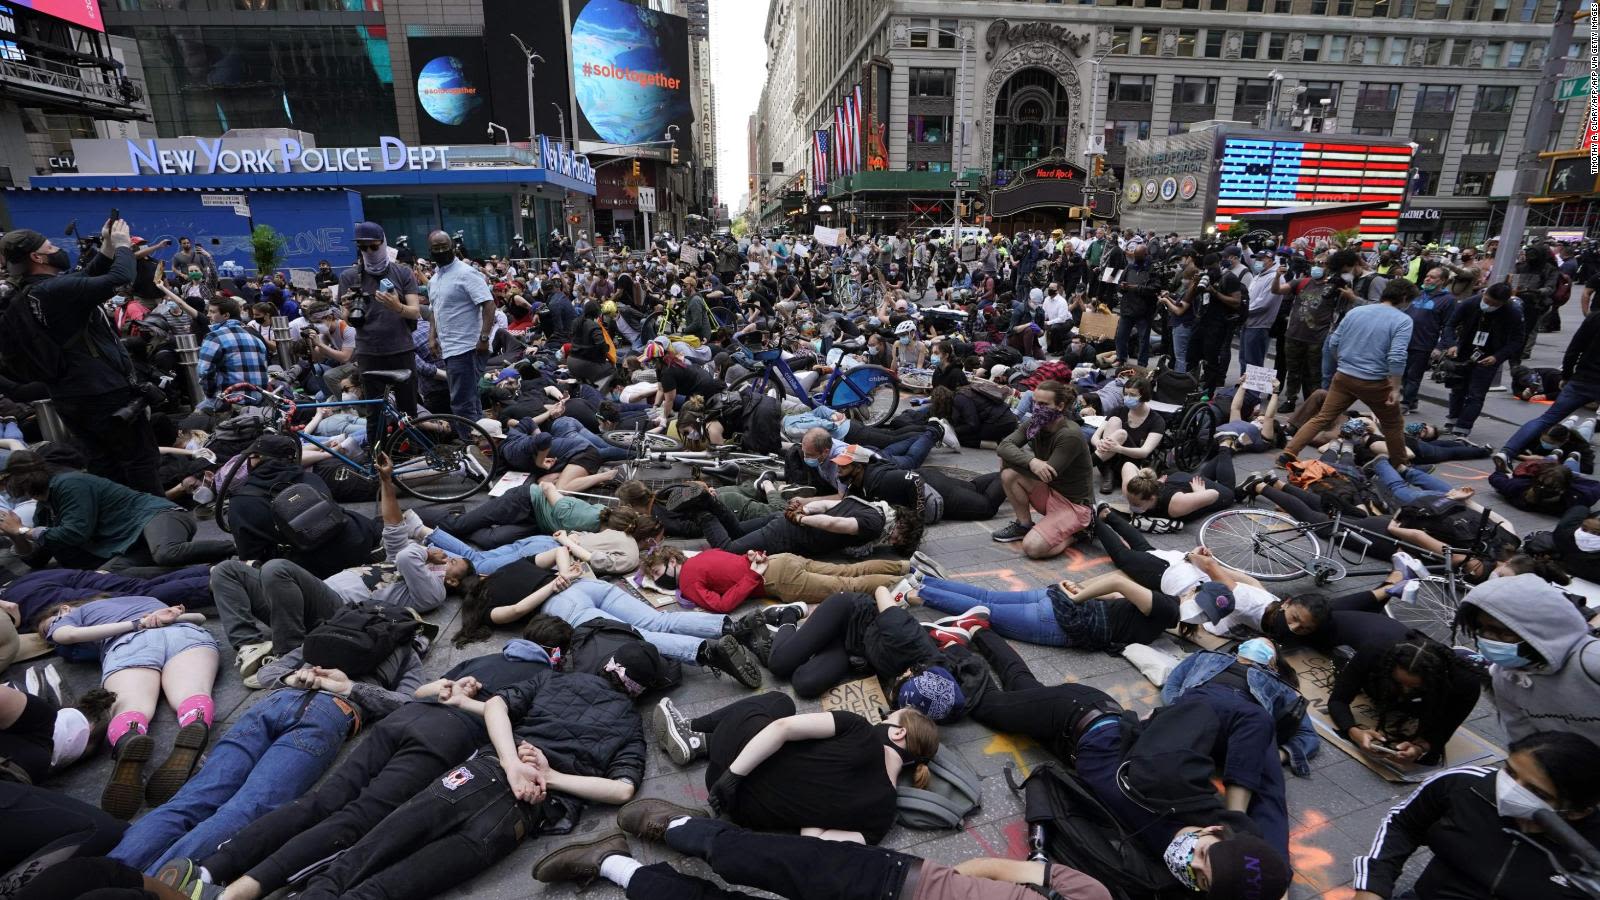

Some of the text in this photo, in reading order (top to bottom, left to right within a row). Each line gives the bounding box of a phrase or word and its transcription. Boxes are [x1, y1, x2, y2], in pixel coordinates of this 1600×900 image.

[985, 18, 1090, 61] Paramount
[582, 62, 681, 90] #solotogether
[1562, 80, 1578, 97] W
[702, 103, 711, 161] CARTER
[126, 135, 449, 175] NEW YORK POLICE DEPT
[1036, 168, 1073, 179] Hard Rock
[279, 227, 349, 255] LOVE
[829, 681, 865, 705] SAY
